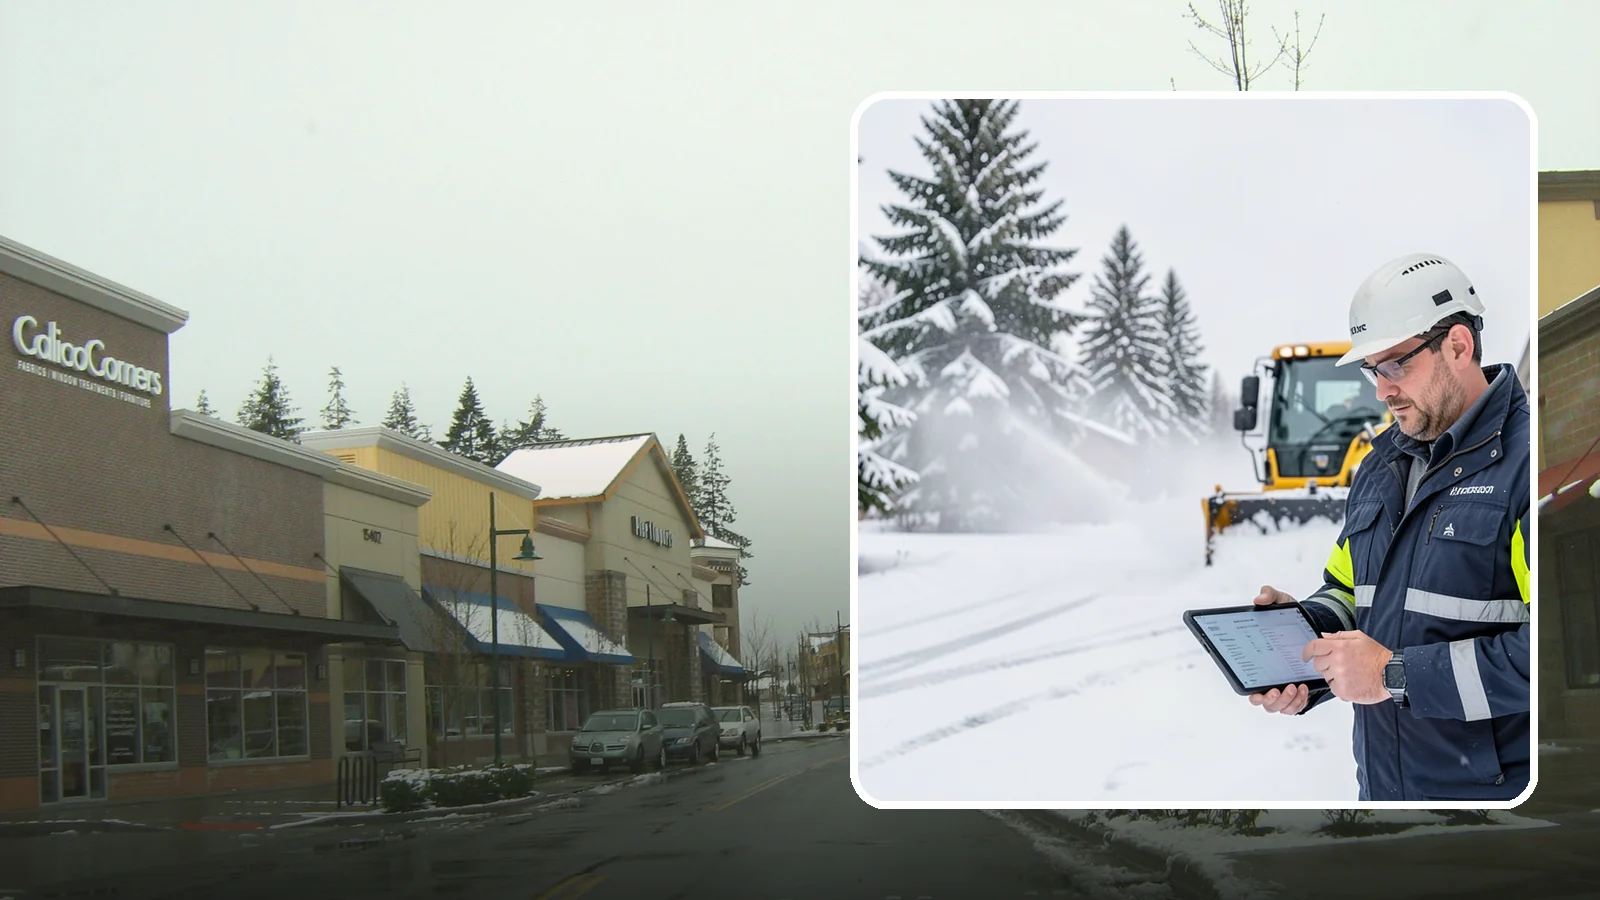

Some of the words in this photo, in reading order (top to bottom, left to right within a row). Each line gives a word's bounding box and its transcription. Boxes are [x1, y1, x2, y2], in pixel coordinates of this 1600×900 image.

[16, 359, 47, 378] FABRICS
[51, 370, 78, 387] WINDOW
[78, 378, 117, 399] TREATMENTS
